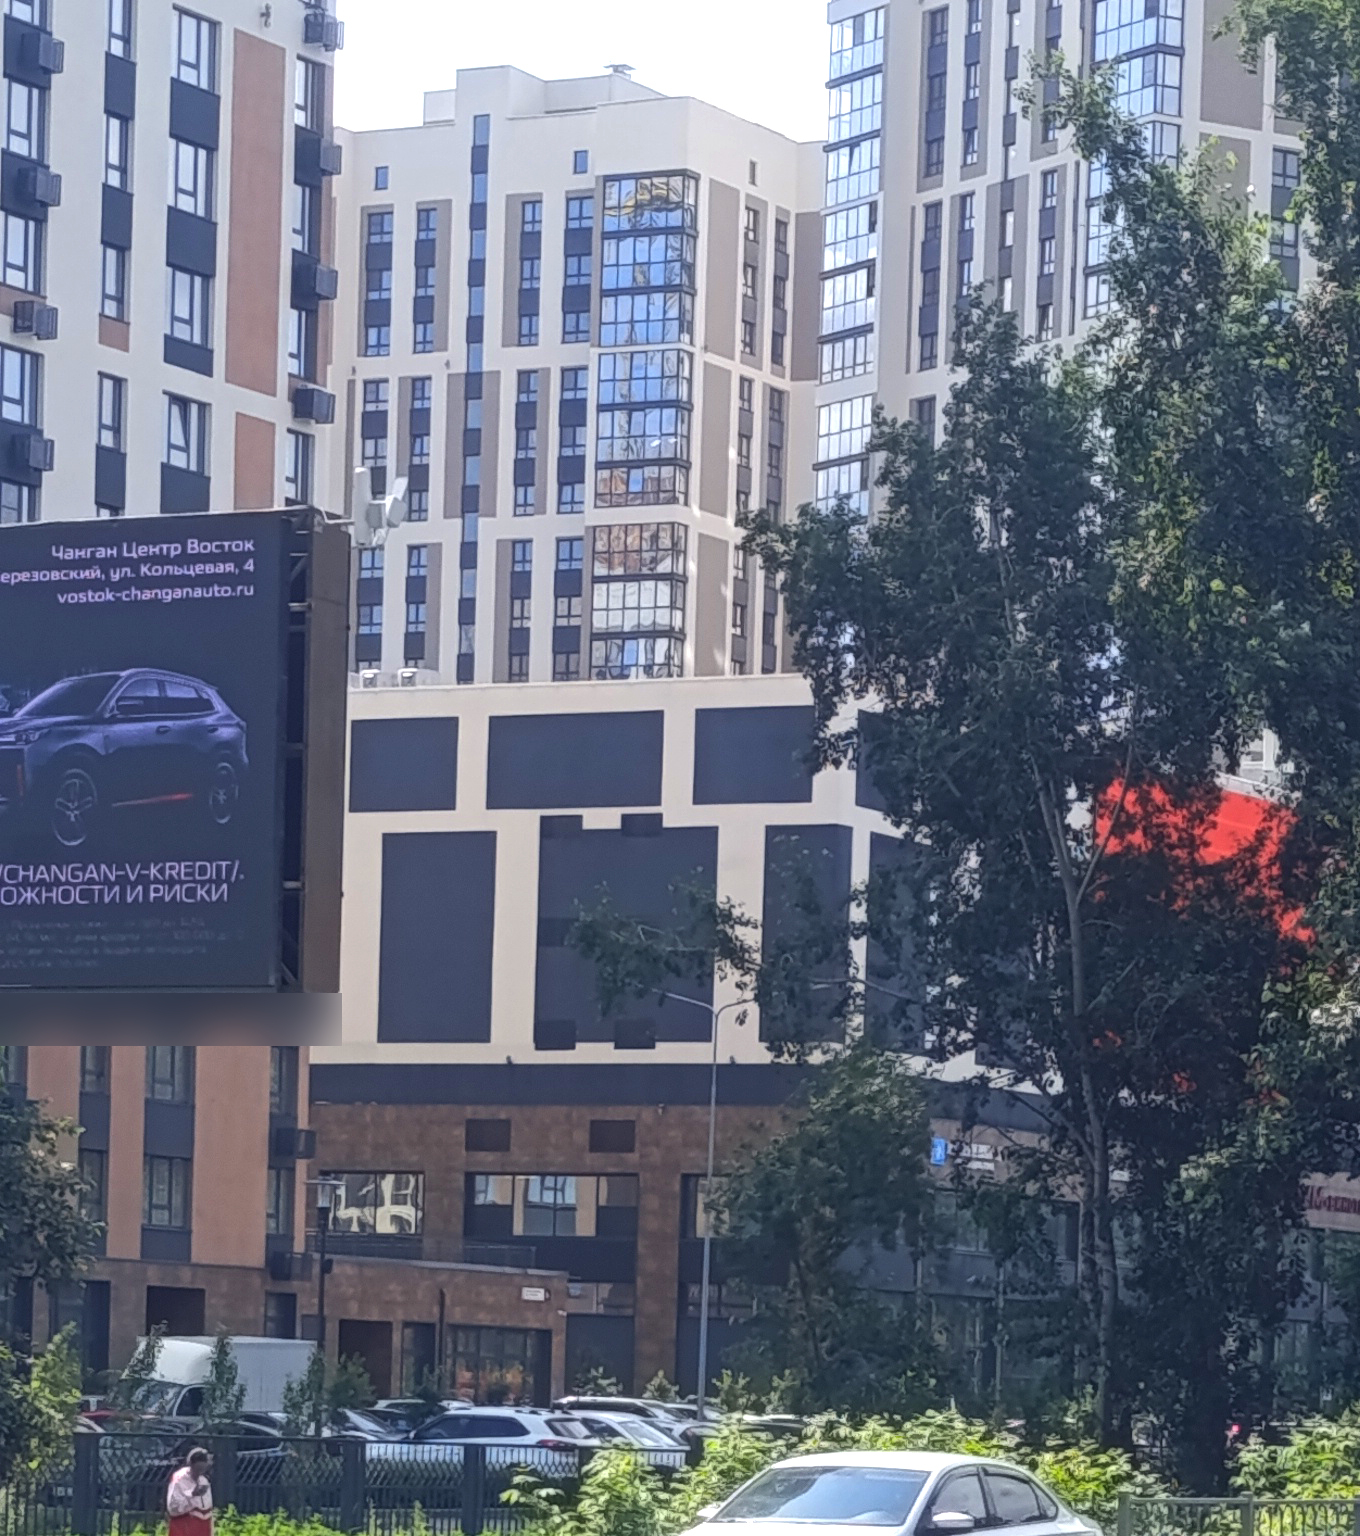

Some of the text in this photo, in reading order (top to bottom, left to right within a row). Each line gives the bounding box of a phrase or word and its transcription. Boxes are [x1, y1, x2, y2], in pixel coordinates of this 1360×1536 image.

[51, 539, 255, 561] Чанган Центр Восток
[110, 567, 136, 581] ул.
[140, 561, 239, 577] Кольцевая,
[243, 559, 255, 572] 4
[57, 585, 255, 605] vostok-changanauto.ru
[126, 883, 143, 903] И
[149, 882, 228, 903] РИСКИ
